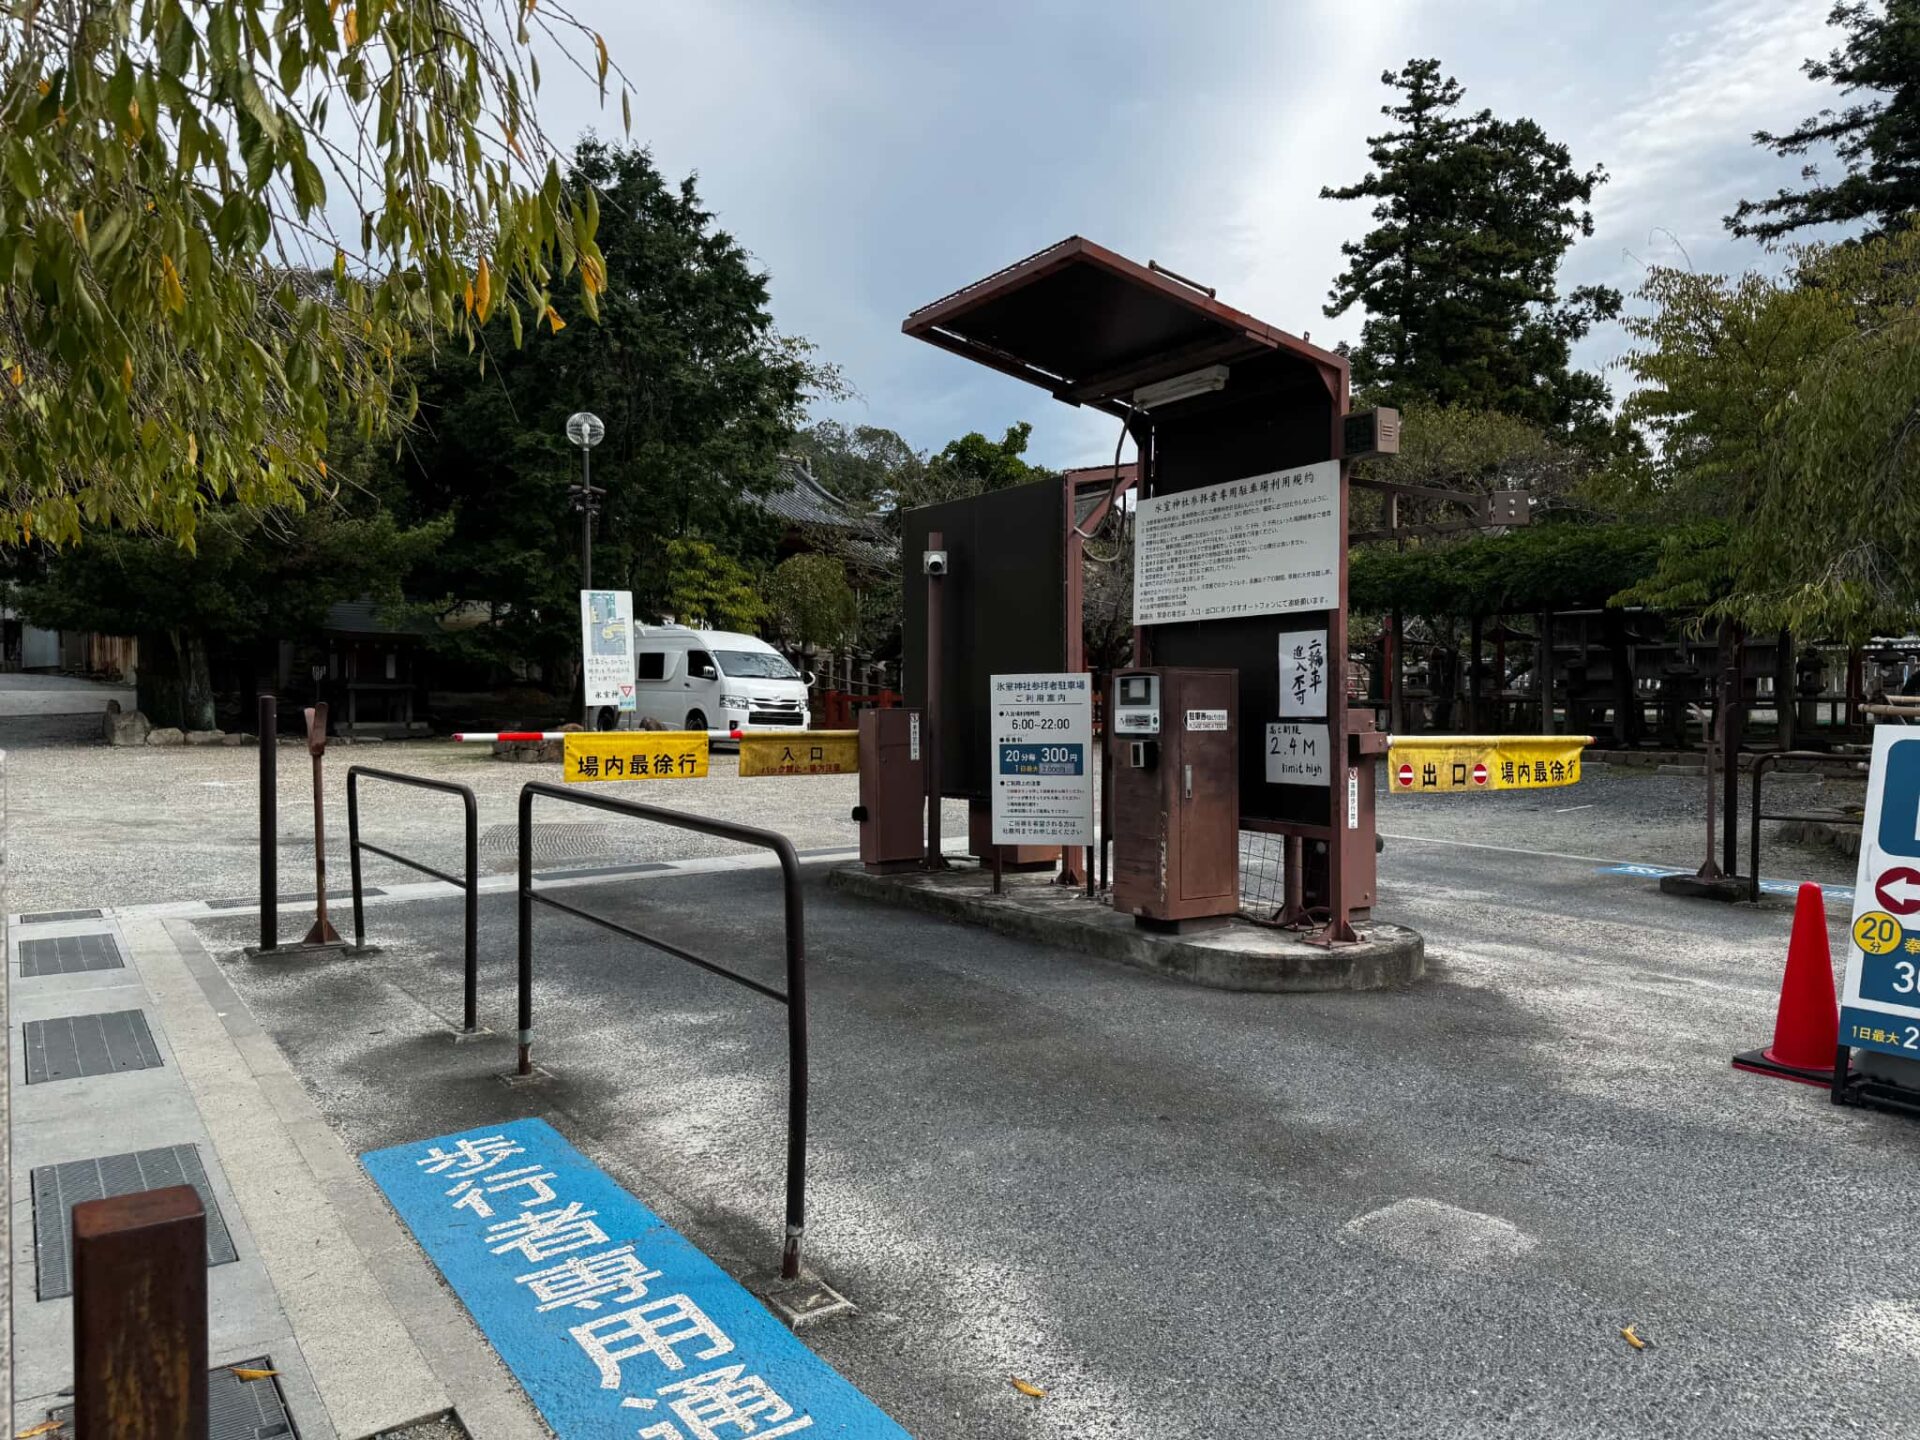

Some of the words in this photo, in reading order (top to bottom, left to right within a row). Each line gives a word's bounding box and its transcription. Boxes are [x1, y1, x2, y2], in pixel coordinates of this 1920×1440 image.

[1291, 645, 1307, 705] 進入不可
[1308, 639, 1324, 694] 二輪車
[1015, 693, 1066, 703] ご利用案内
[782, 746, 823, 761] 入口
[1041, 747, 1078, 762] 300円
[577, 753, 698, 777] 場内最徐行
[1306, 763, 1322, 777] high
[1422, 762, 1467, 787] 出口
[1861, 917, 1895, 942] 20
[1869, 942, 1882, 953] 分
[1892, 961, 1920, 995] 3
[1852, 1025, 1900, 1046] 1日最大
